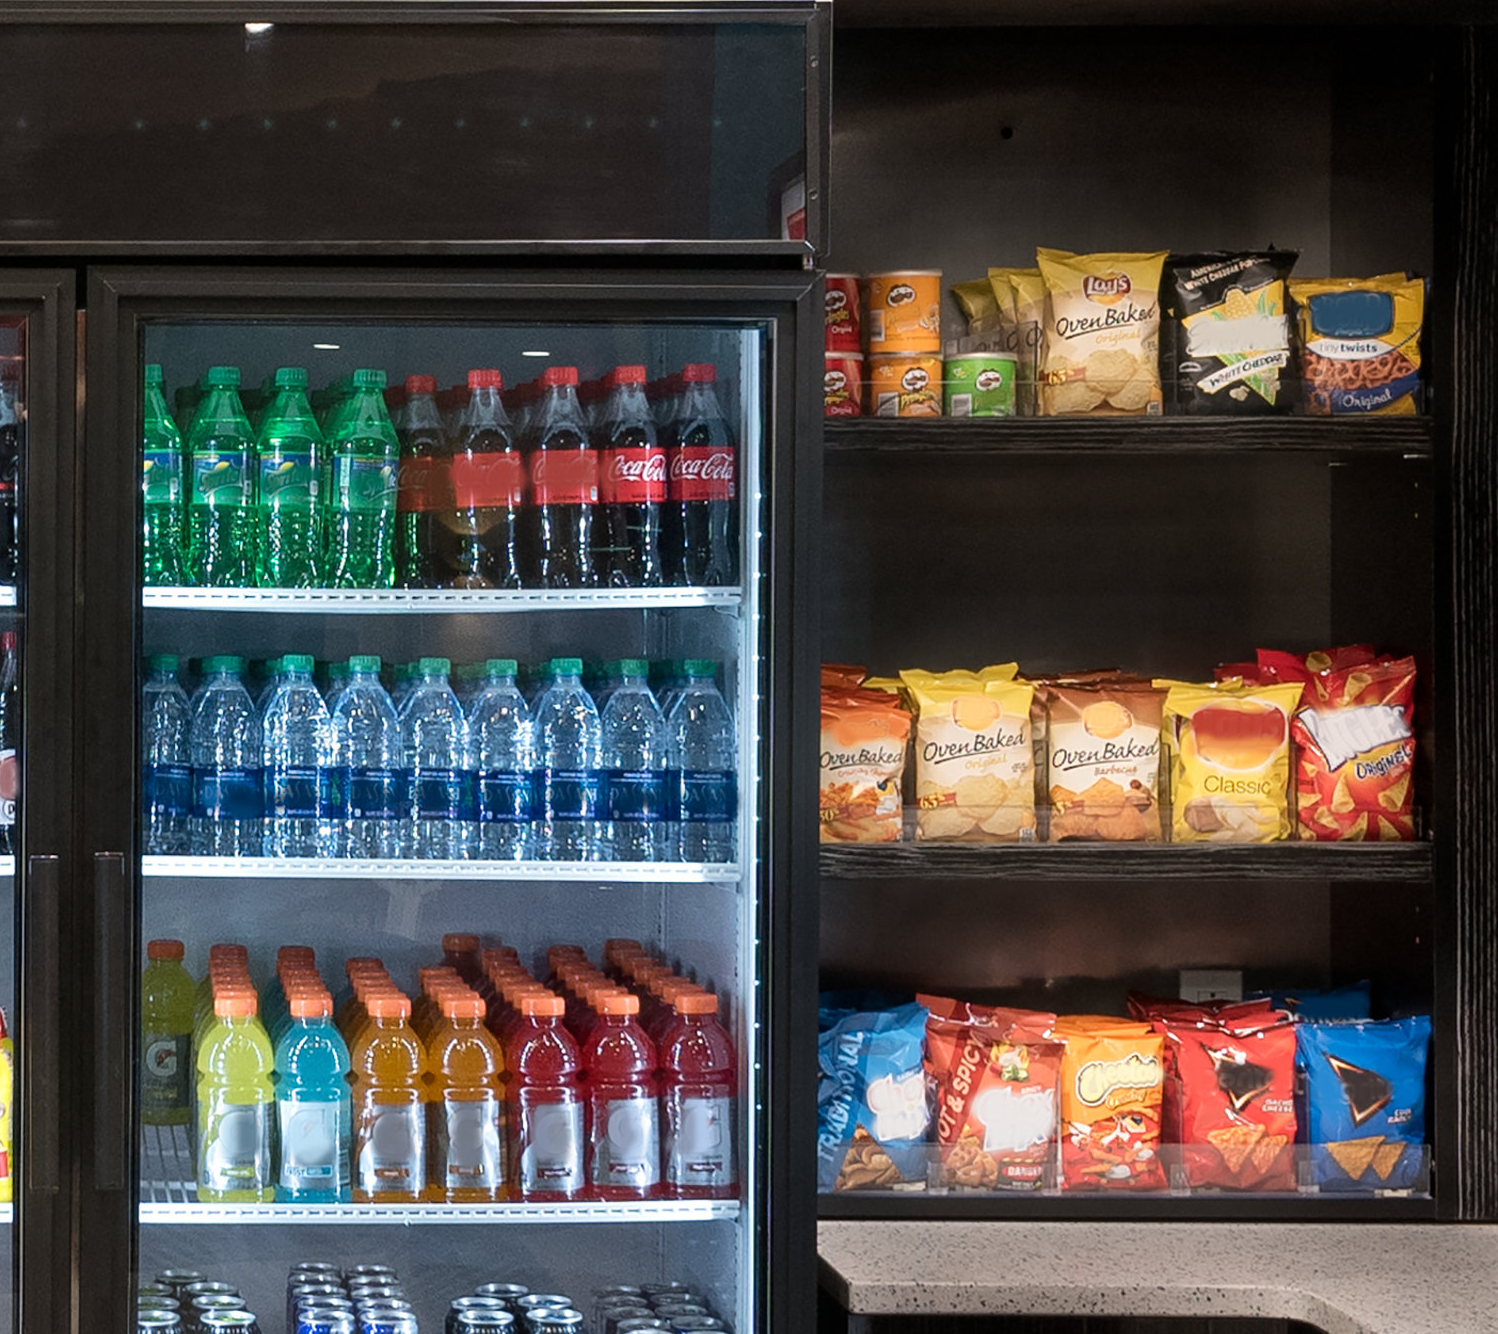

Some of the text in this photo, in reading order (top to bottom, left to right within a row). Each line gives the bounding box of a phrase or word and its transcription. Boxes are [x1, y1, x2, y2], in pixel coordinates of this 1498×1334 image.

[1086, 274, 1131, 295] Lay's
[1055, 301, 1156, 337] Oven Baked
[1095, 328, 1142, 347] Original
[1340, 342, 1378, 353] twists
[1209, 353, 1285, 389] WHITE CHEDDAR
[1343, 388, 1392, 410] Original
[922, 728, 1026, 763] Oven Baked
[1052, 738, 1159, 769] Oven Baked
[820, 746, 903, 768] Oven Baked
[964, 754, 1008, 772] Original
[1094, 764, 1139, 776] Barbecue
[1203, 774, 1272, 796] Classic
[947, 1092, 964, 1114] &
